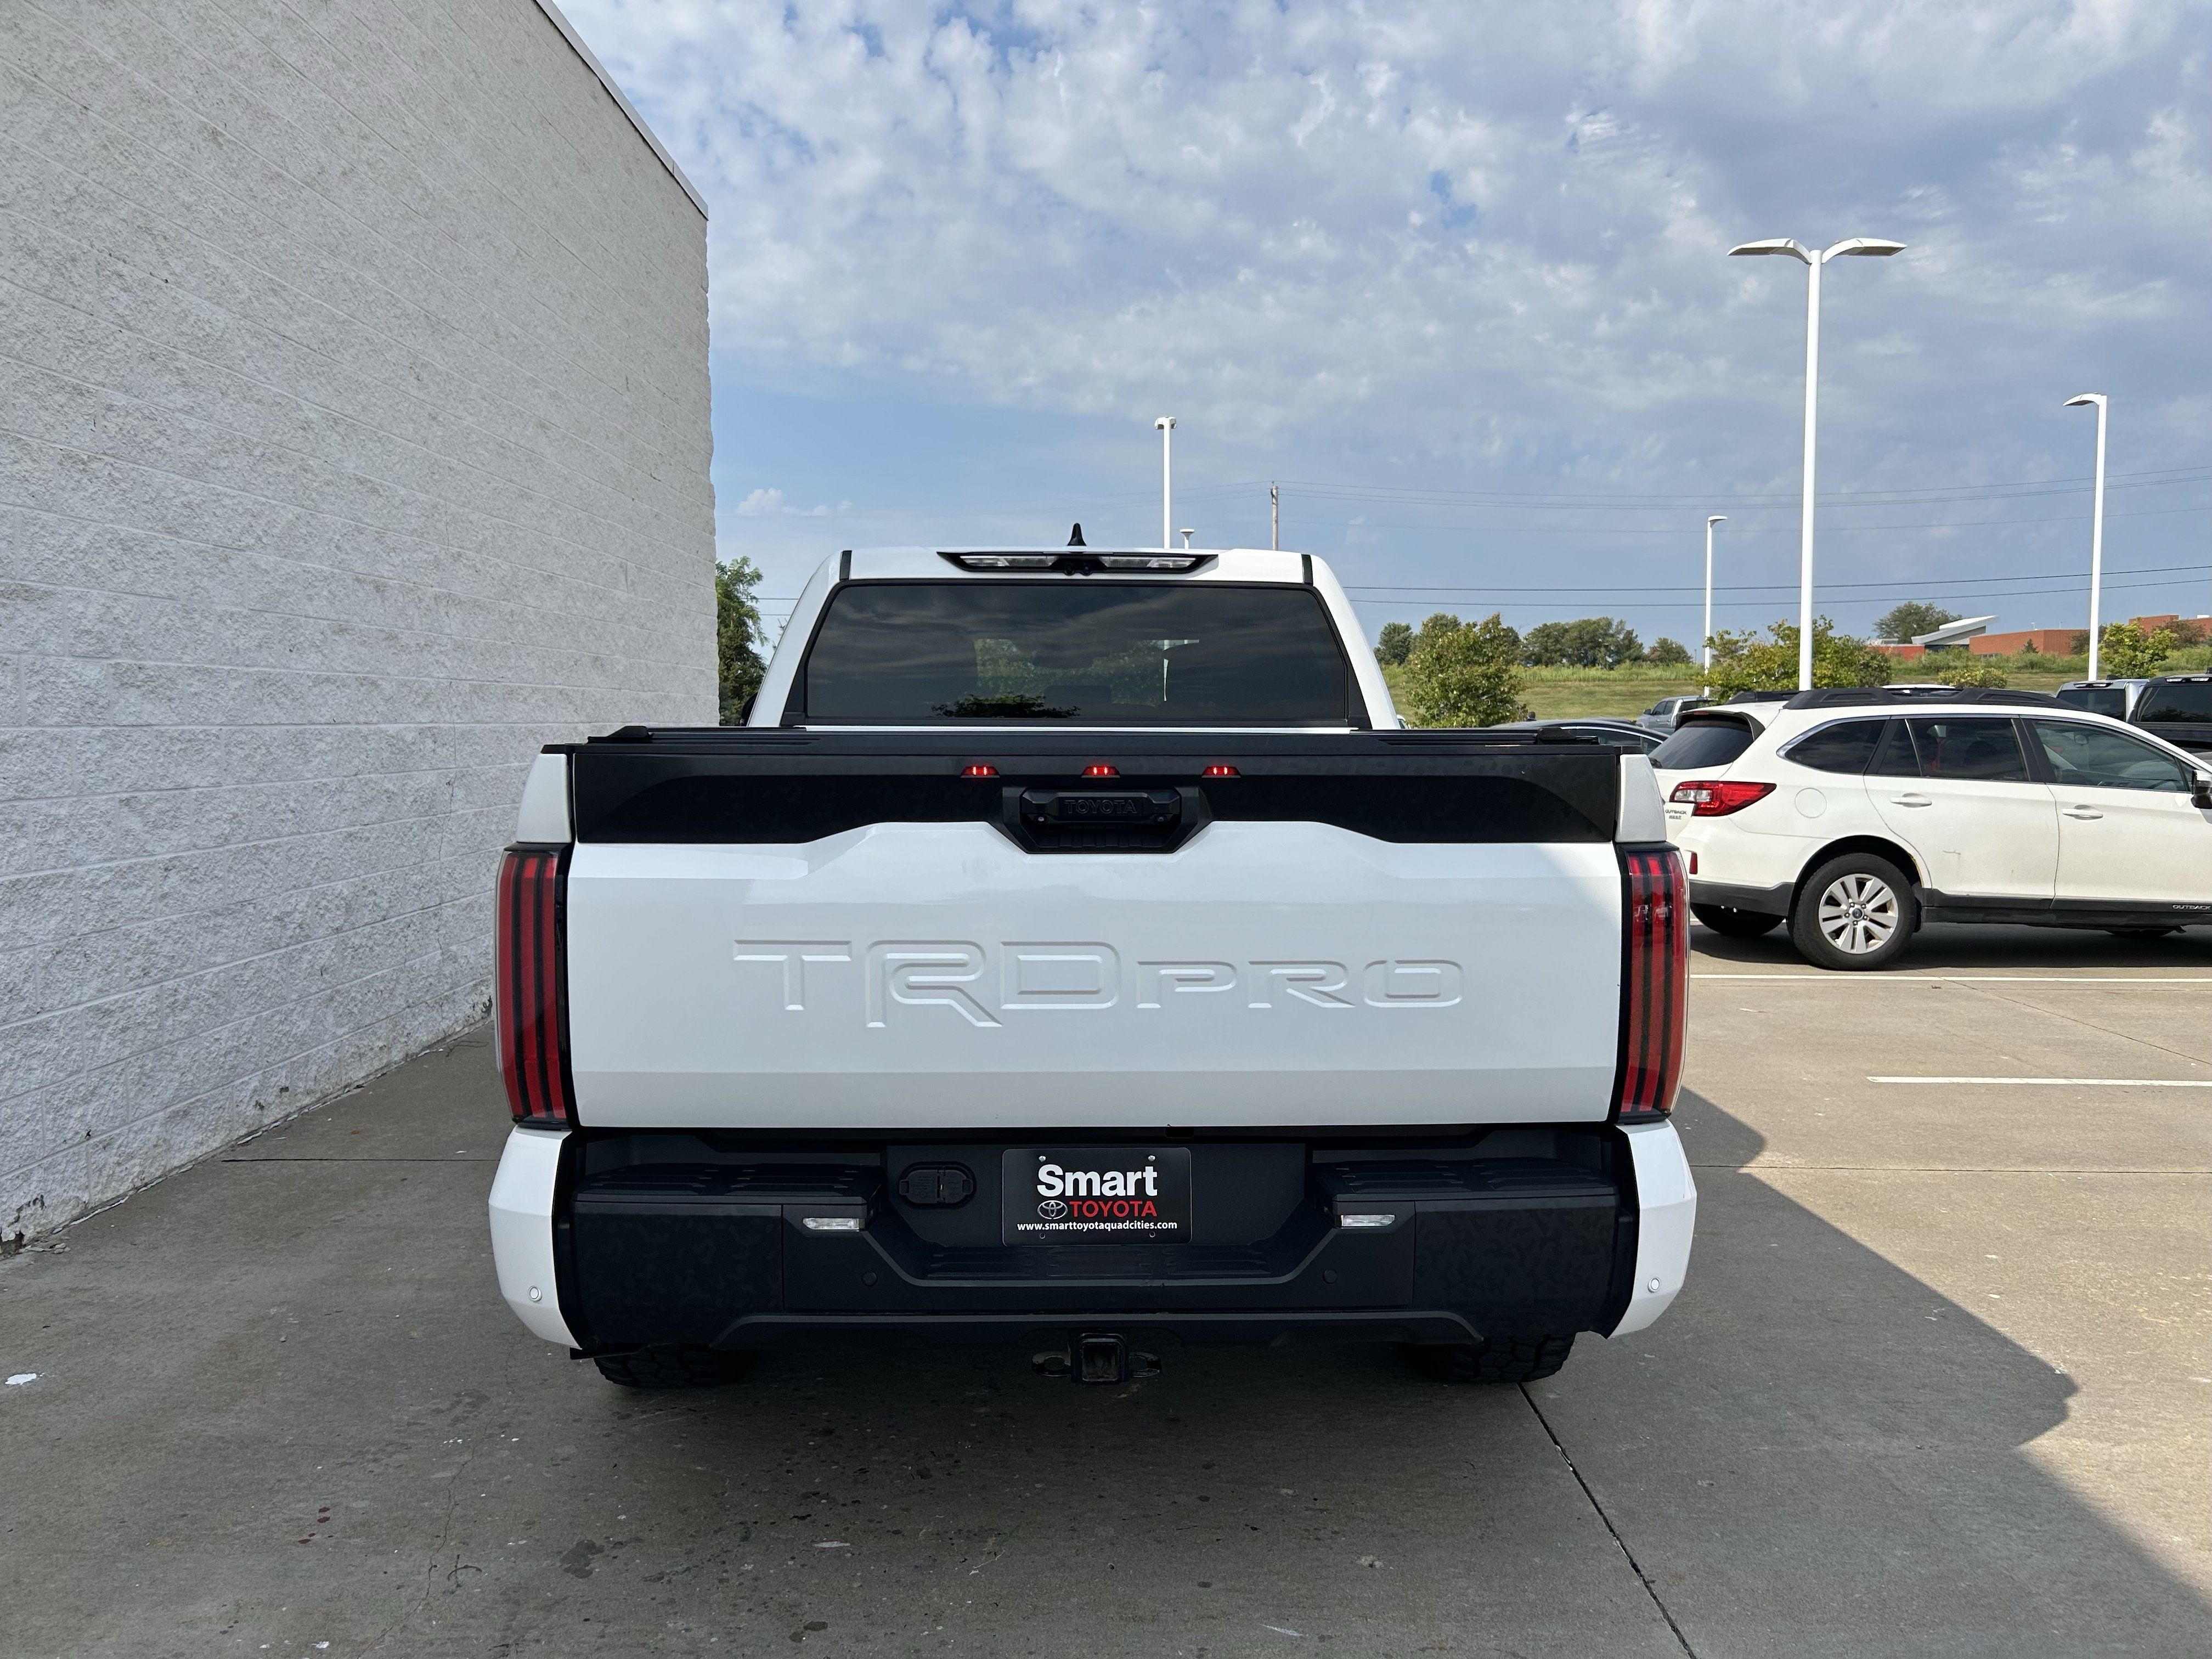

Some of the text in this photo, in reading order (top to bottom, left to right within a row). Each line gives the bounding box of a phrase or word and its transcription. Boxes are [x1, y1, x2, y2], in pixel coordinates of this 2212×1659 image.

[1064, 800, 1137, 814] TOYOTA
[733, 939, 1466, 1028] TRD PRO
[1037, 1164, 1158, 1197] Smart
[1069, 1200, 1158, 1217] TOYOTA
[1017, 1220, 1177, 1232] www.smarttoyotaquadcities.com
